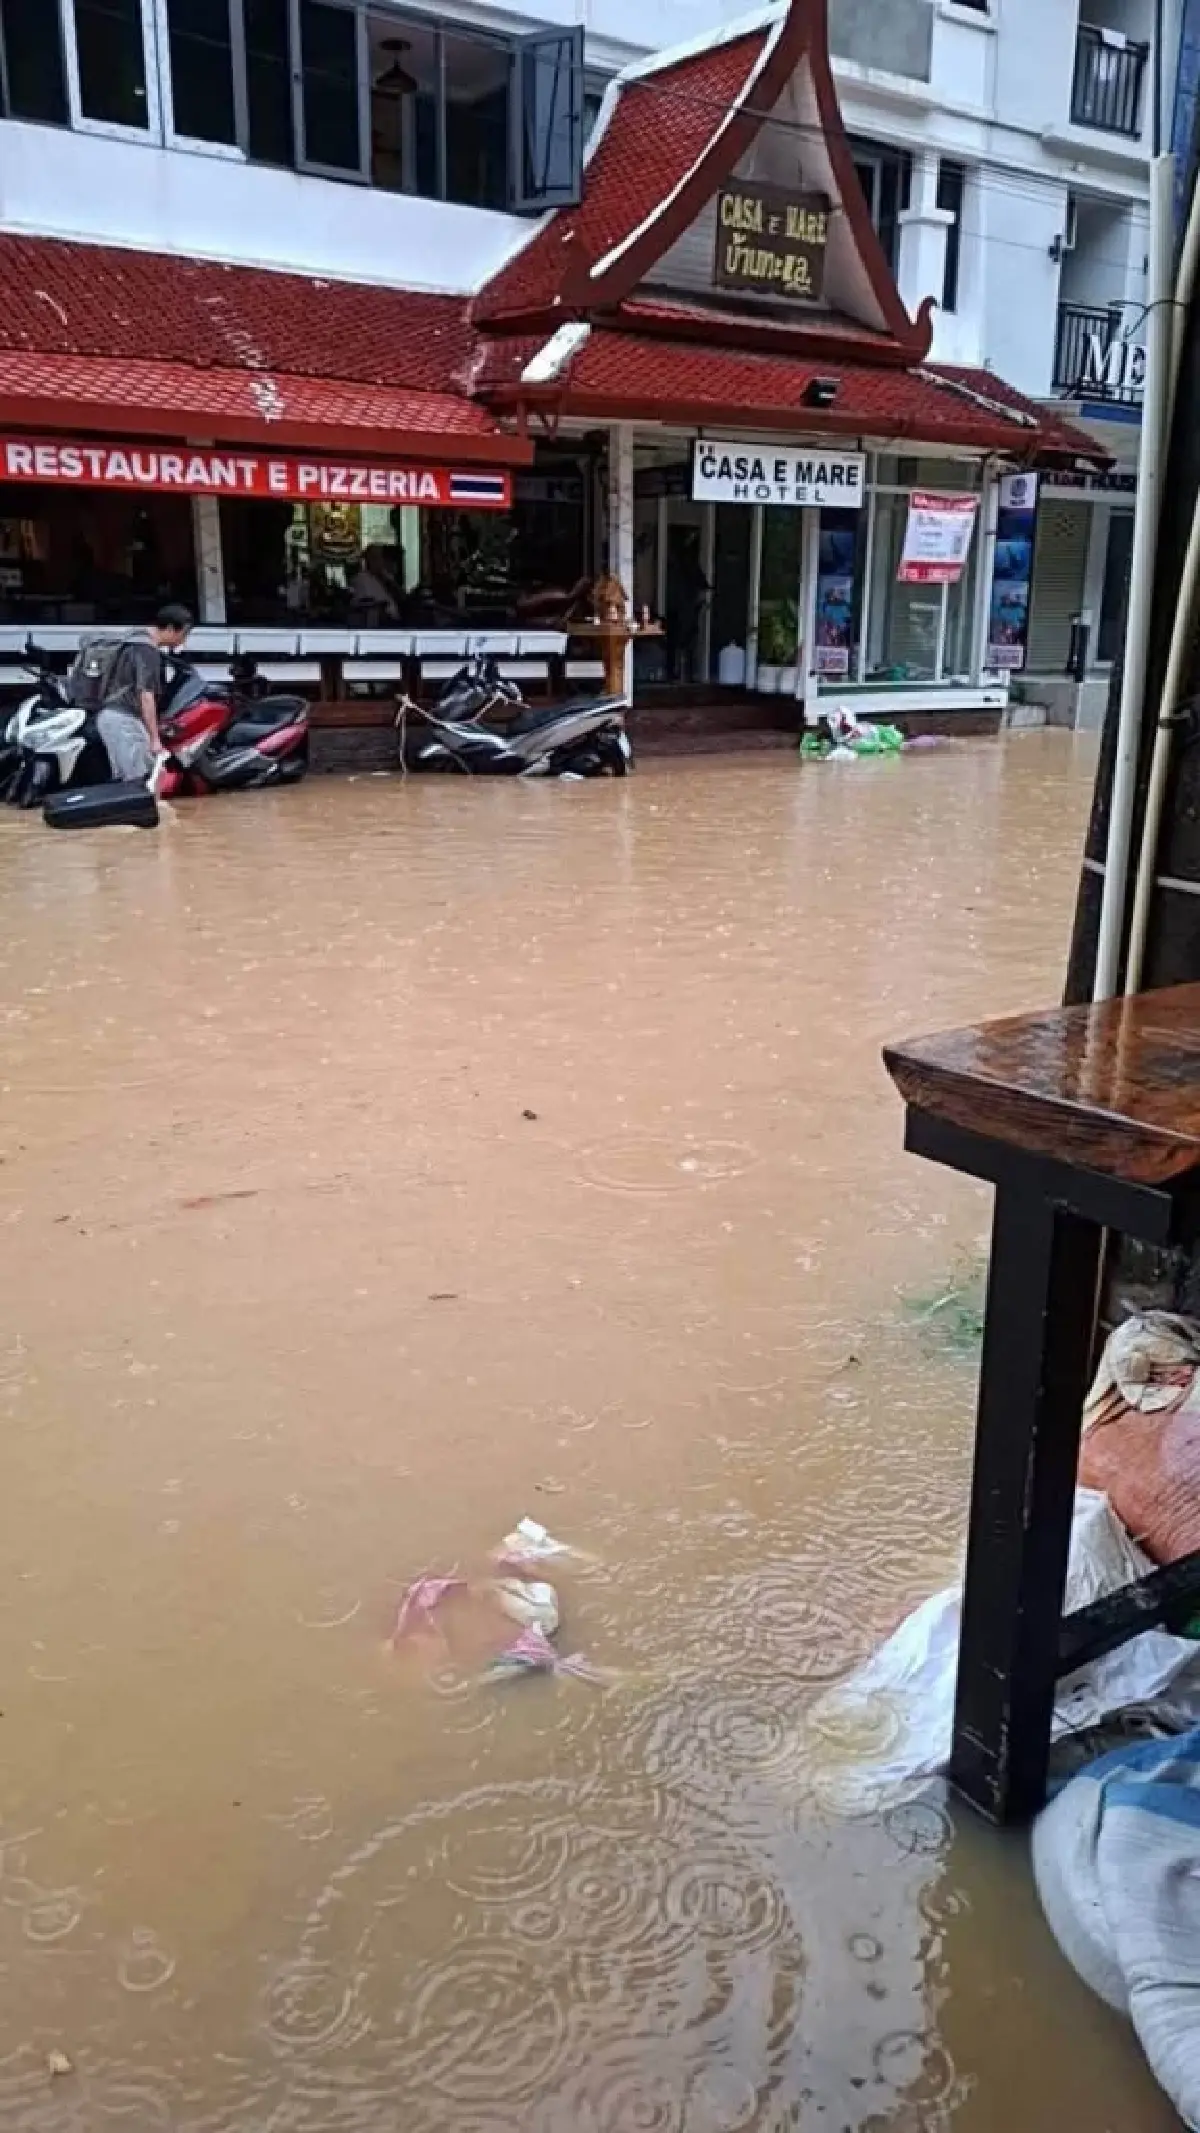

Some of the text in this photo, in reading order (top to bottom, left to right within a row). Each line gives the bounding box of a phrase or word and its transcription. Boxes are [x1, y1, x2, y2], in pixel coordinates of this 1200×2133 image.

[721, 194, 827, 243] CASA E MARE
[6, 443, 440, 499] RESTAURANT E PIZZERIA
[701, 456, 859, 486] CASA E MARE
[734, 484, 826, 502] HOTEL
